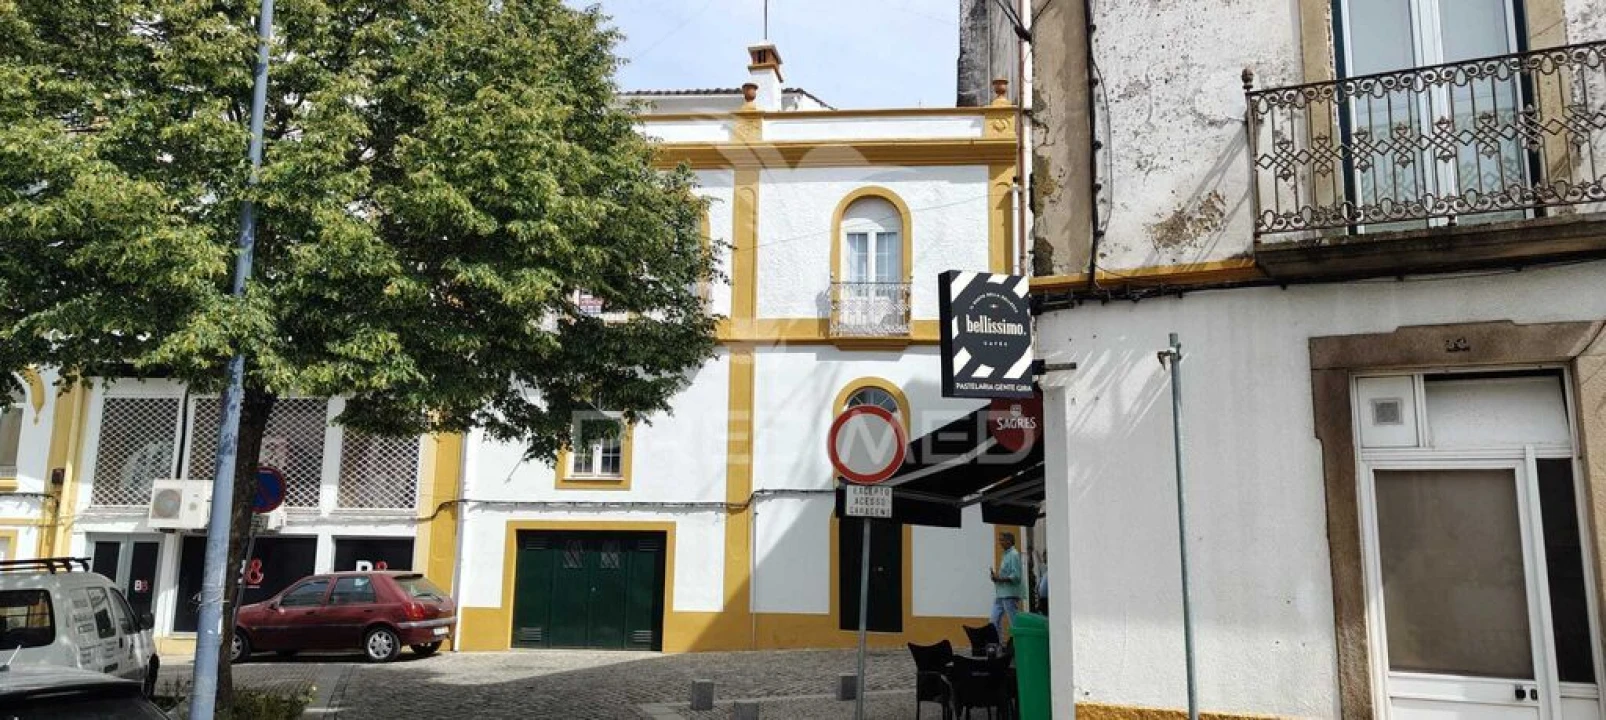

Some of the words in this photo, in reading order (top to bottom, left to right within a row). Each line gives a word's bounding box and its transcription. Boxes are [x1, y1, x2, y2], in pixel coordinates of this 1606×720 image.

[966, 314, 1027, 336] bellissimo.
[956, 382, 994, 390] PASTELARIA
[996, 416, 1037, 430] SAGRES
